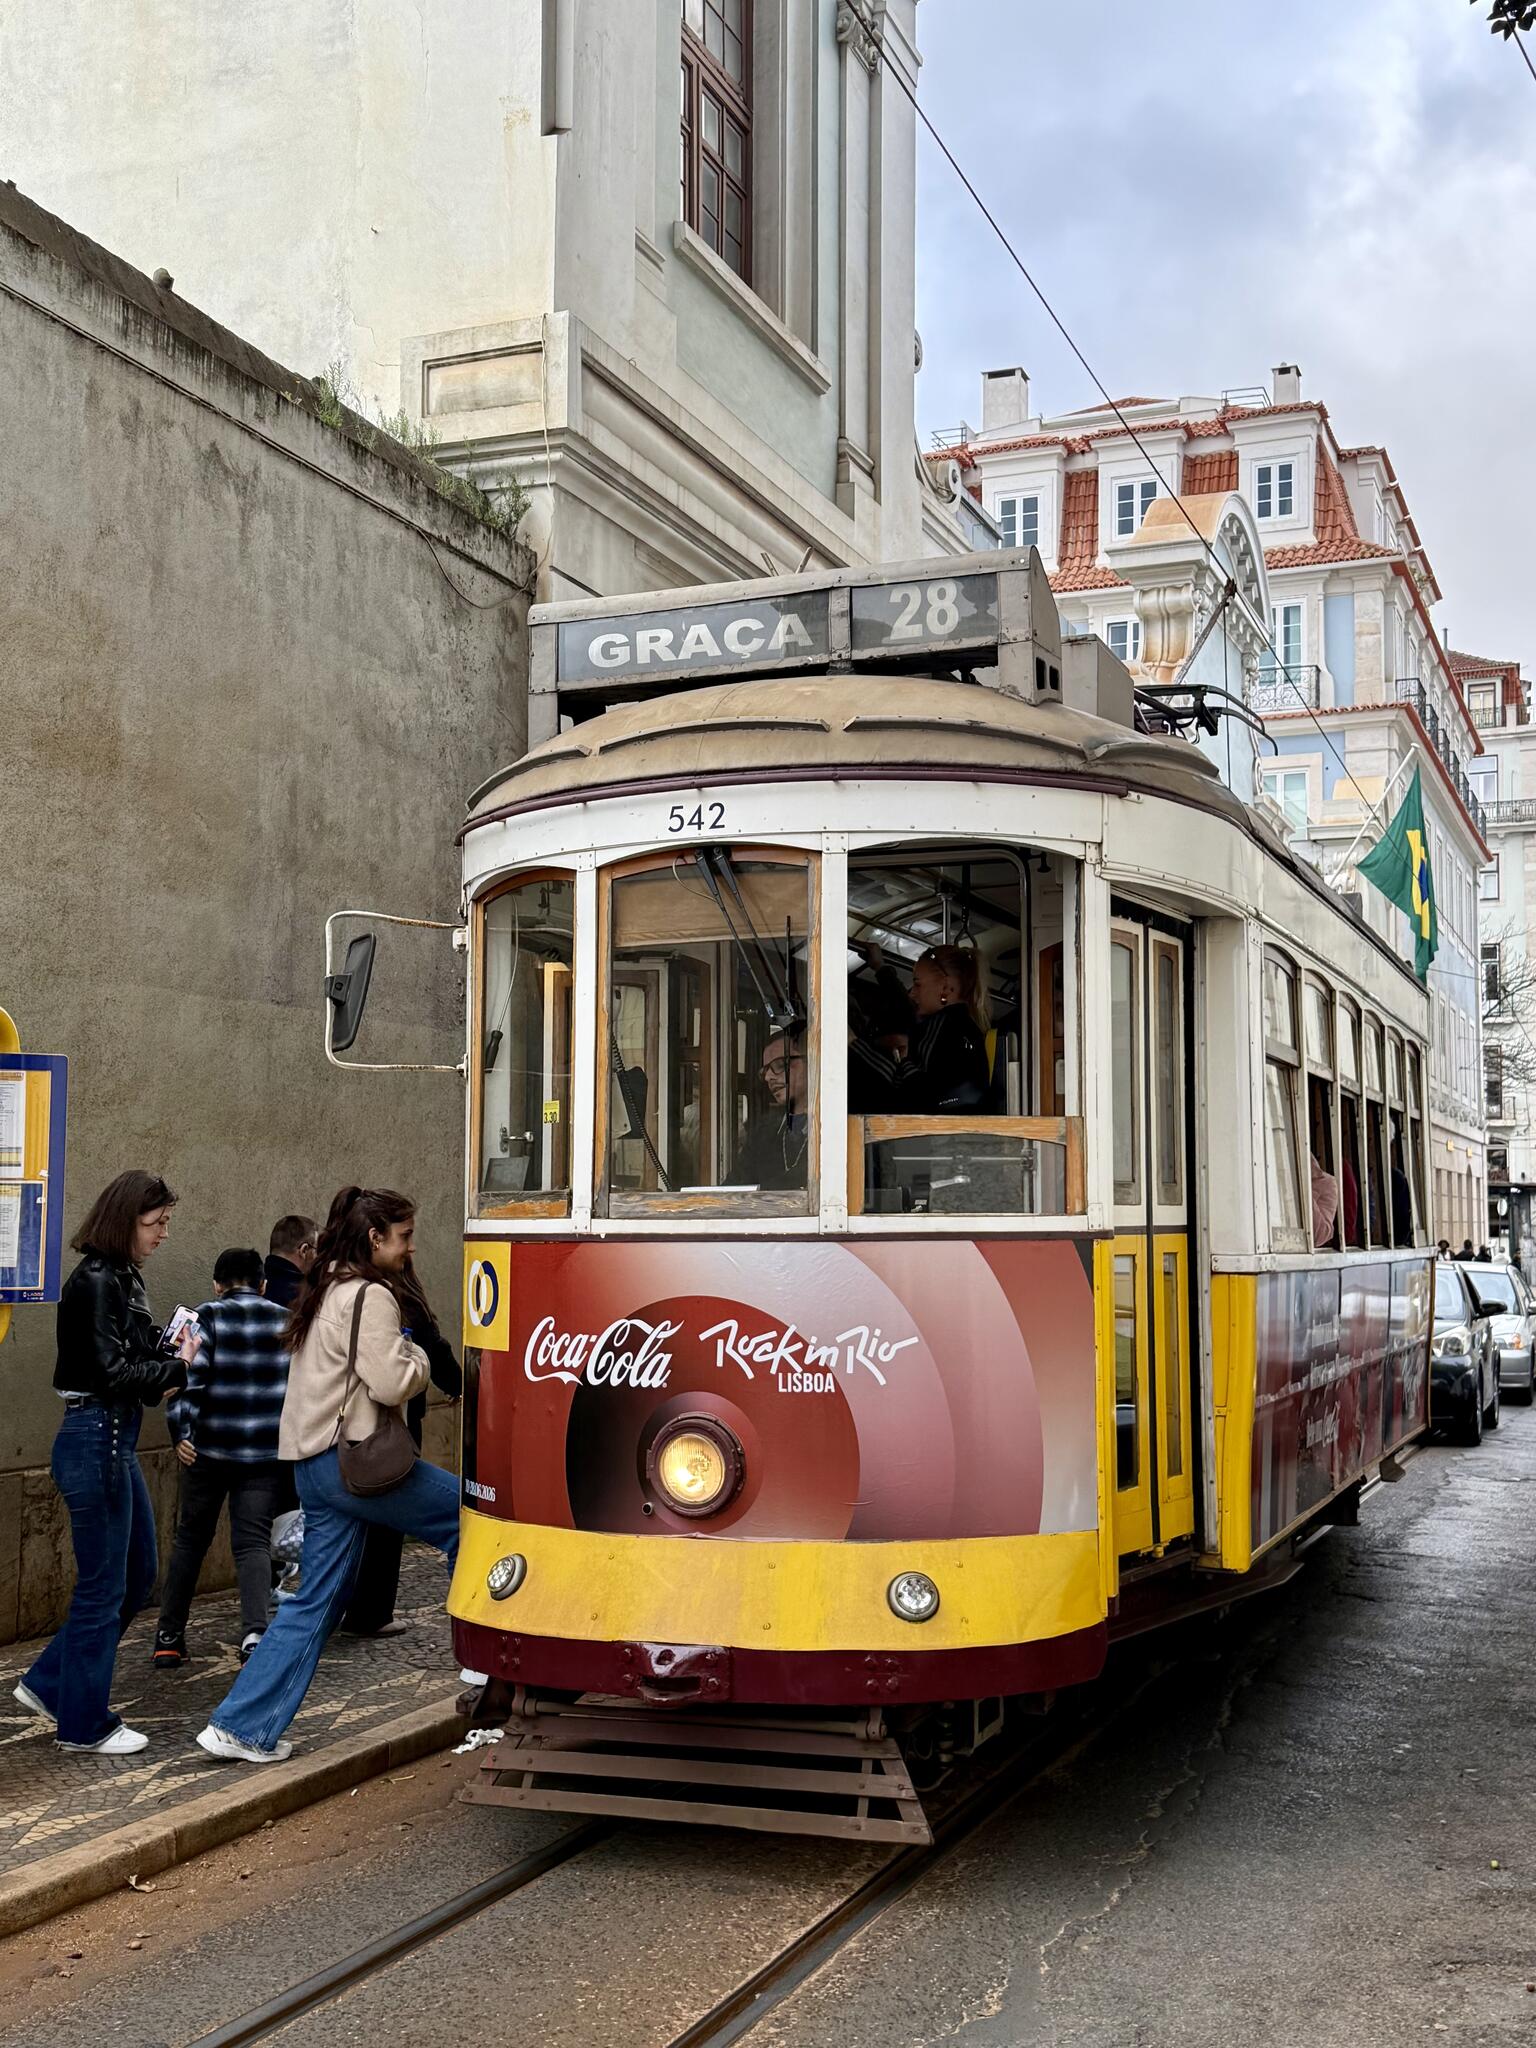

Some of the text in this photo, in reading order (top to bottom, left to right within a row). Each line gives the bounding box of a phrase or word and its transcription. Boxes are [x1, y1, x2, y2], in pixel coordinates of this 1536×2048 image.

[588, 613, 813, 668] GRAÇA
[885, 581, 959, 643] 28
[668, 802, 725, 832] 542
[524, 1316, 685, 1388] Coca-Cola
[699, 1319, 919, 1386] Rock in Rio
[778, 1372, 835, 1393] LISBOA
